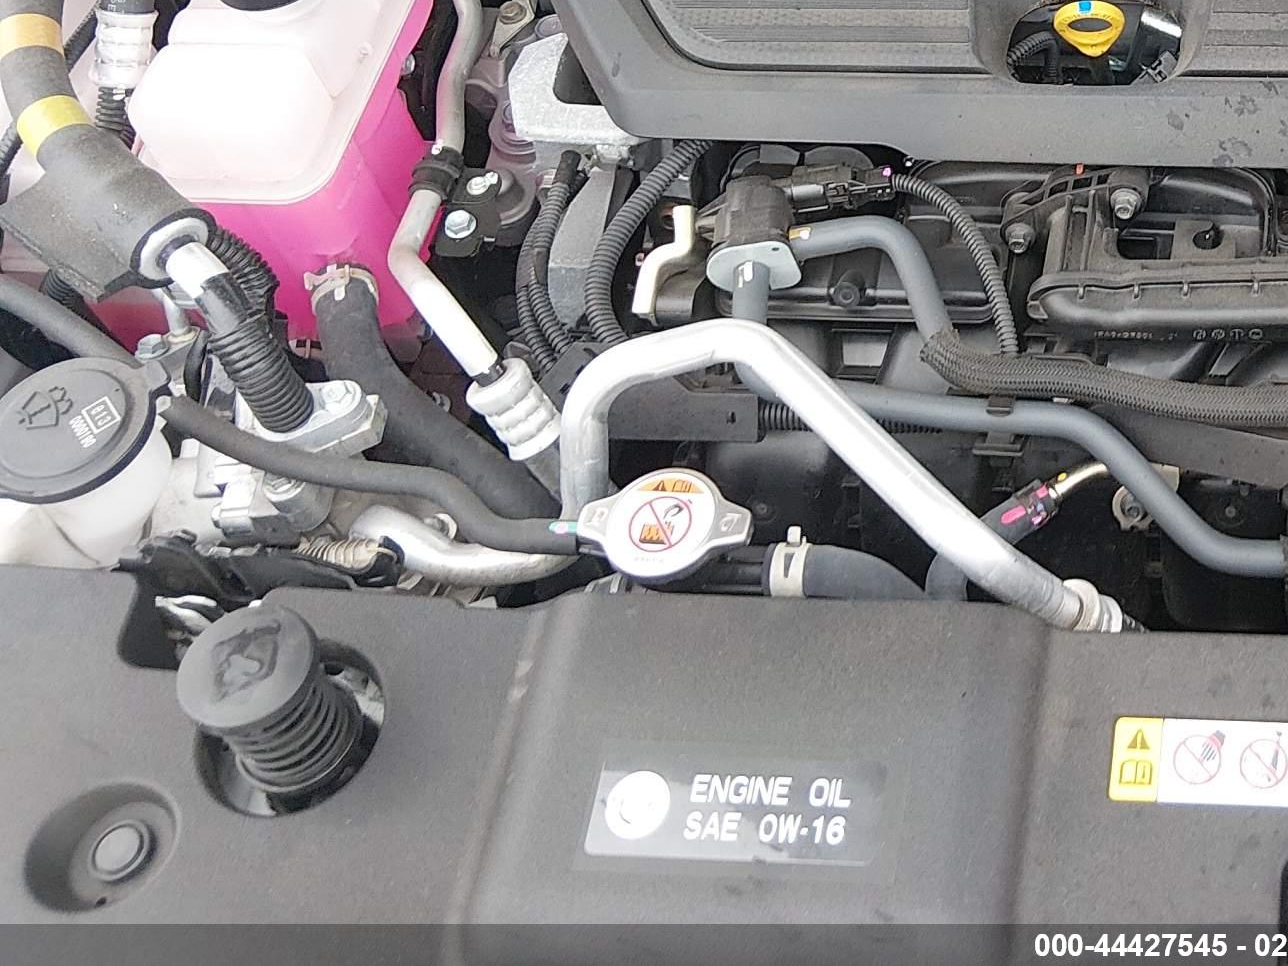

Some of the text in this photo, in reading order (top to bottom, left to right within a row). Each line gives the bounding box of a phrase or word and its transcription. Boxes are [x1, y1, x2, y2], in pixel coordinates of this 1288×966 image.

[689, 774, 851, 808] ENGINE OIL
[683, 810, 846, 845] SAE 0W-16
